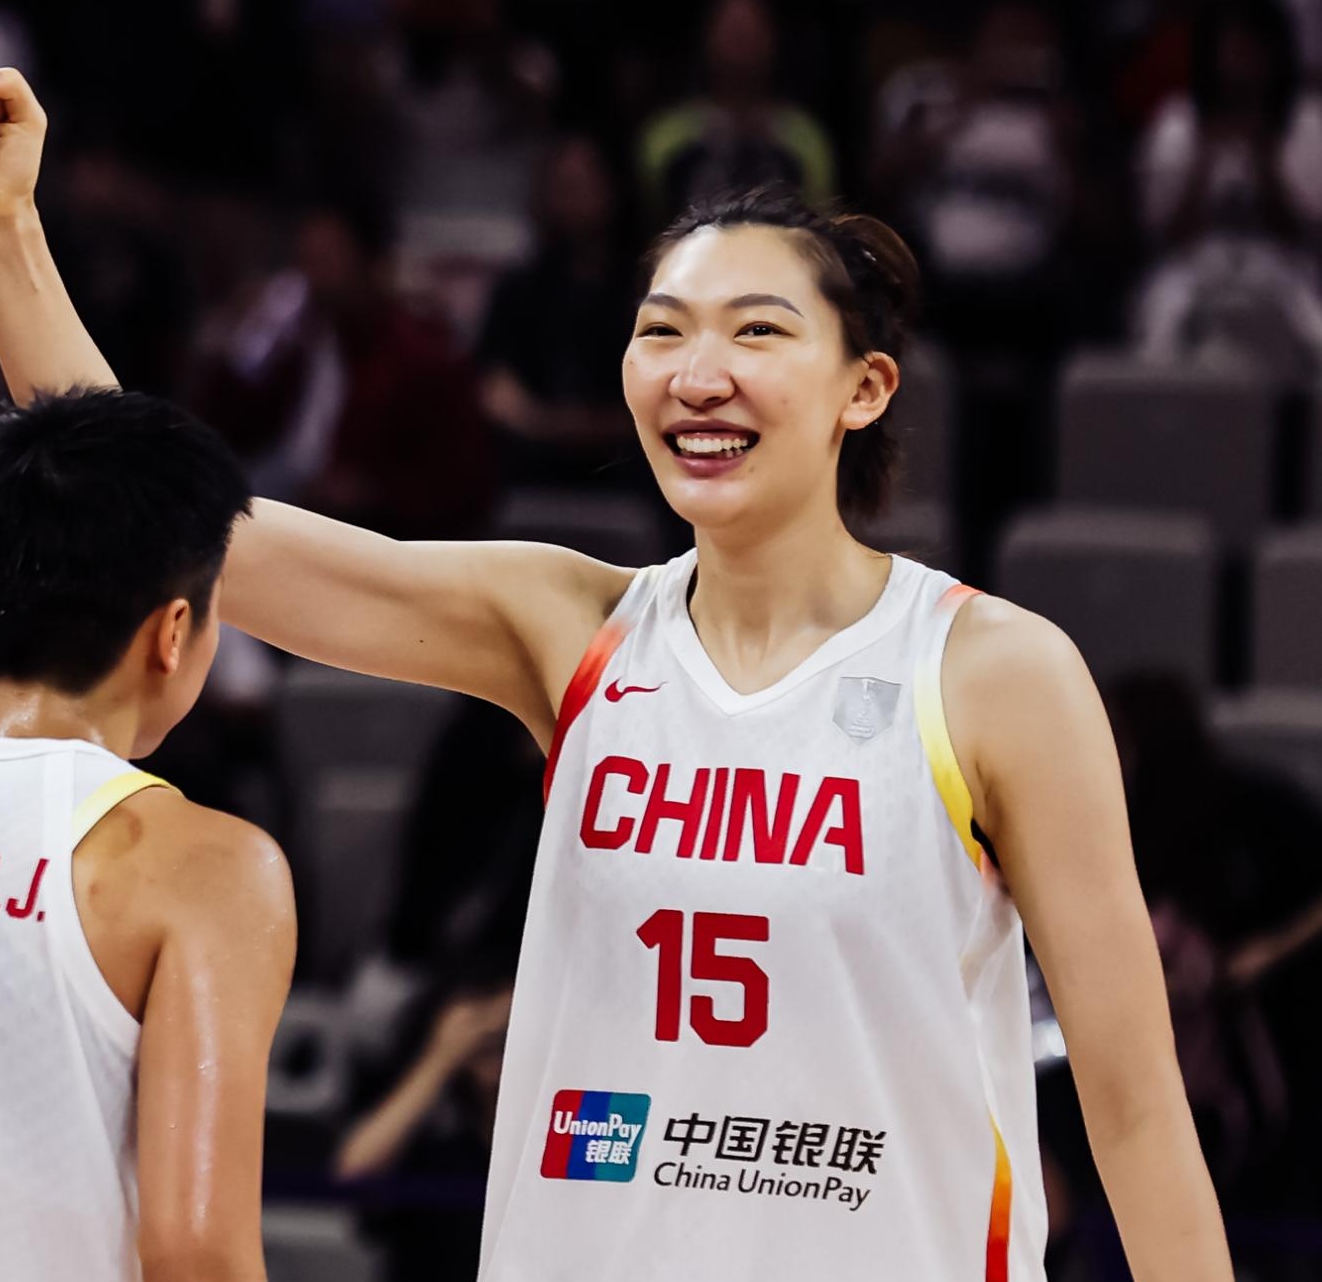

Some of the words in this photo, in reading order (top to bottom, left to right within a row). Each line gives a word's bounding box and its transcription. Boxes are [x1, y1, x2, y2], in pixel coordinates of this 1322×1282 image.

[579, 755, 866, 876] CHINA
[636, 908, 770, 1048] 15
[553, 1110, 642, 1148] UnionPay
[585, 1139, 632, 1166] 银联
[663, 1112, 887, 1175] 中国银联
[653, 1161, 731, 1192] China
[737, 1169, 871, 1211] UnionPay
